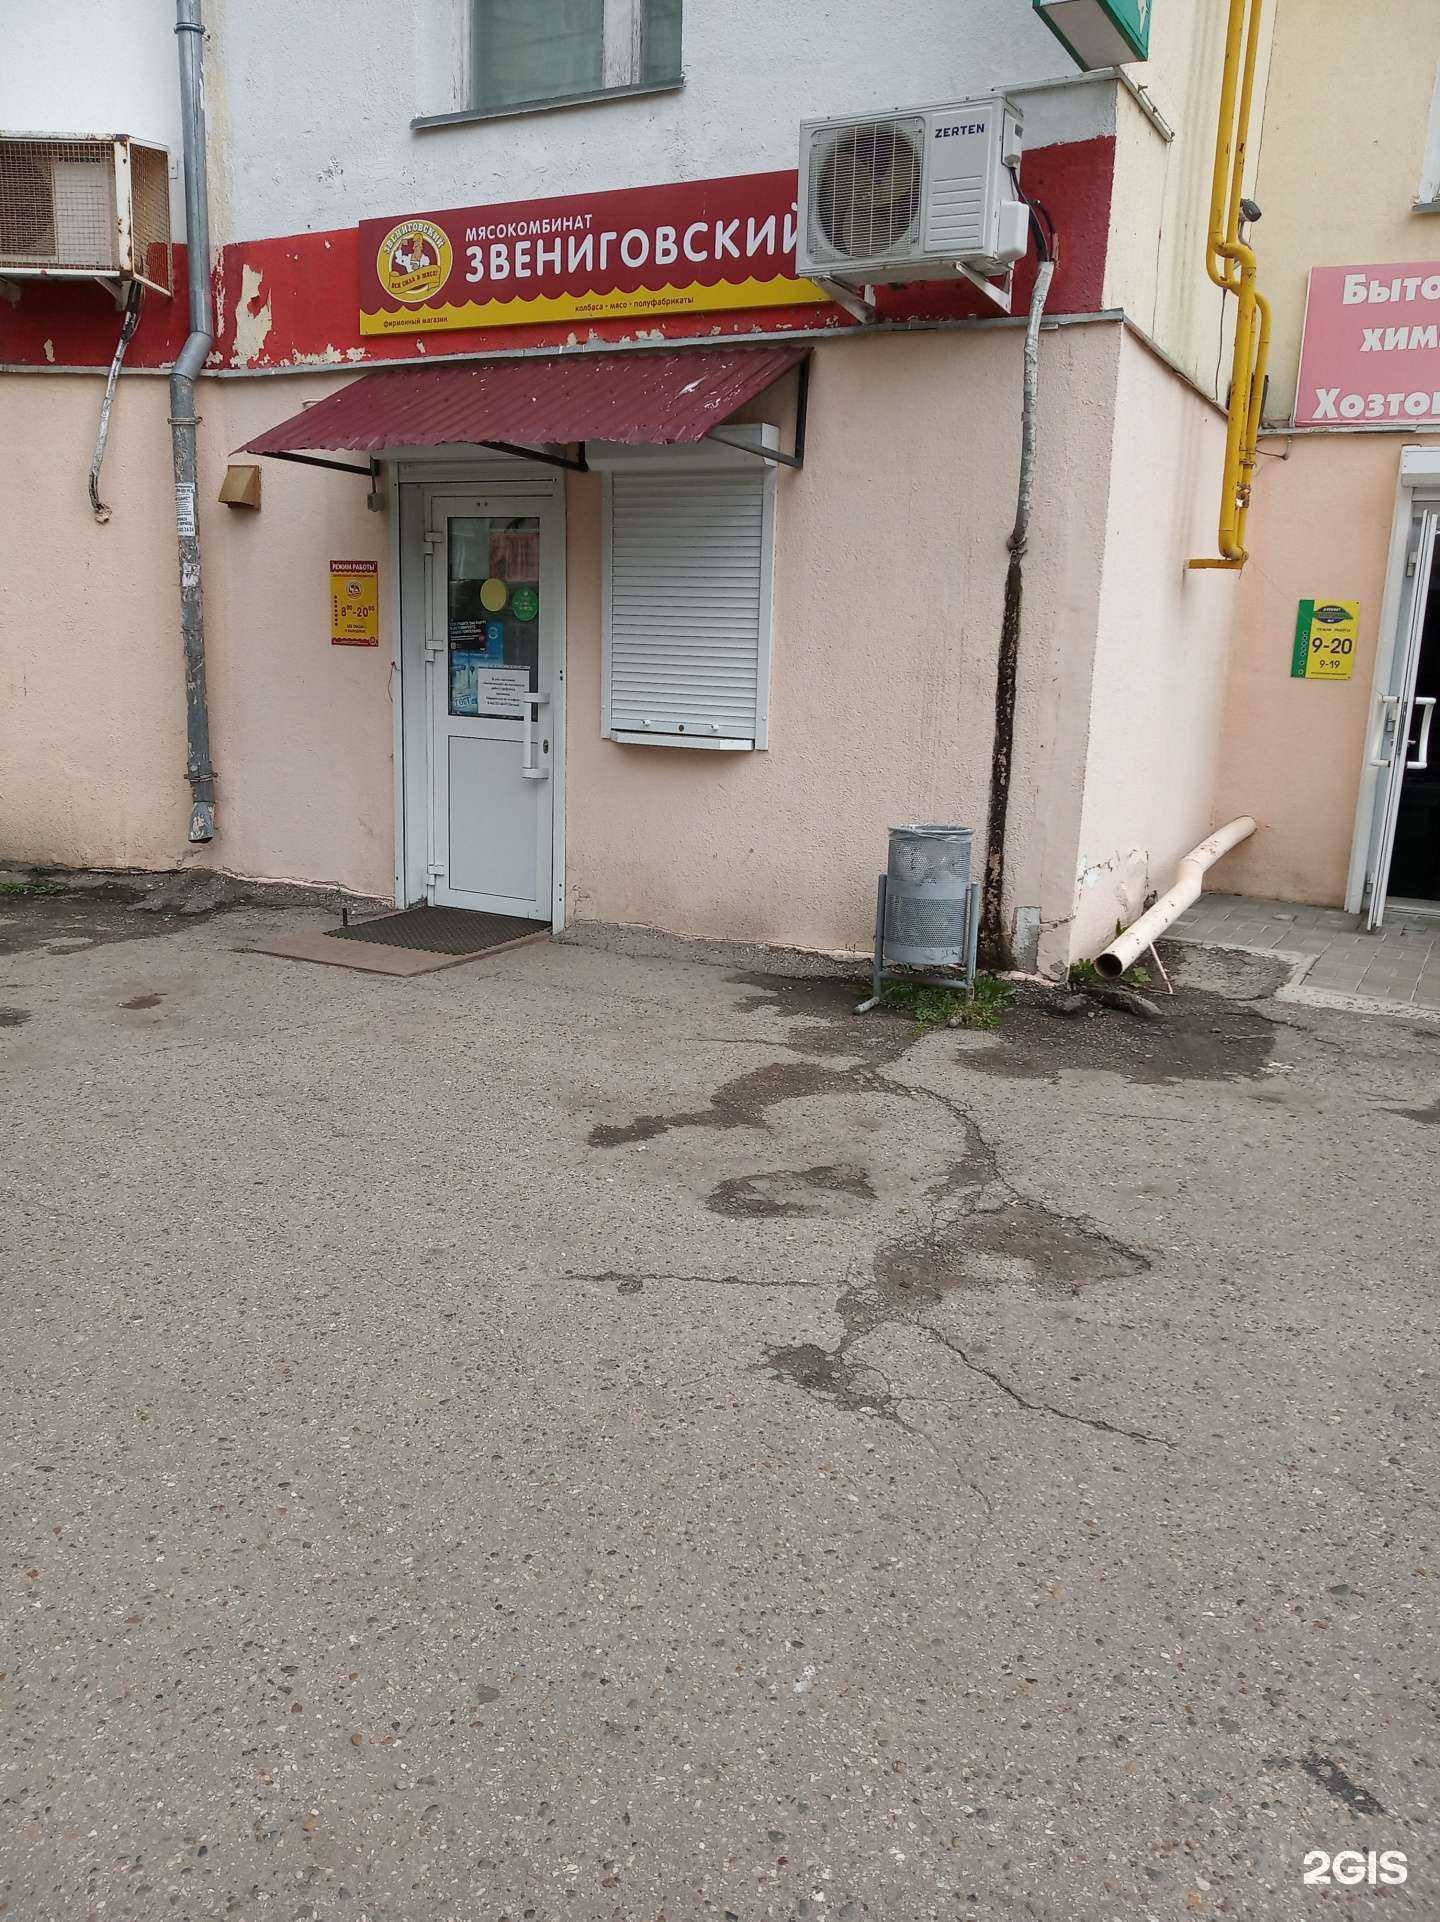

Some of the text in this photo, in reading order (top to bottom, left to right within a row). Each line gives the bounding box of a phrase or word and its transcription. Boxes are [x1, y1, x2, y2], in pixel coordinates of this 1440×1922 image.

[935, 123, 985, 138] ZERTEN
[465, 214, 593, 242] МЯСОКОМБИНАТ
[575, 297, 694, 312] колбаса мясо полуфабрикаты
[1360, 325, 1440, 352] хим
[1312, 637, 1352, 654] 9-20
[1320, 660, 1340, 669] 9-19
